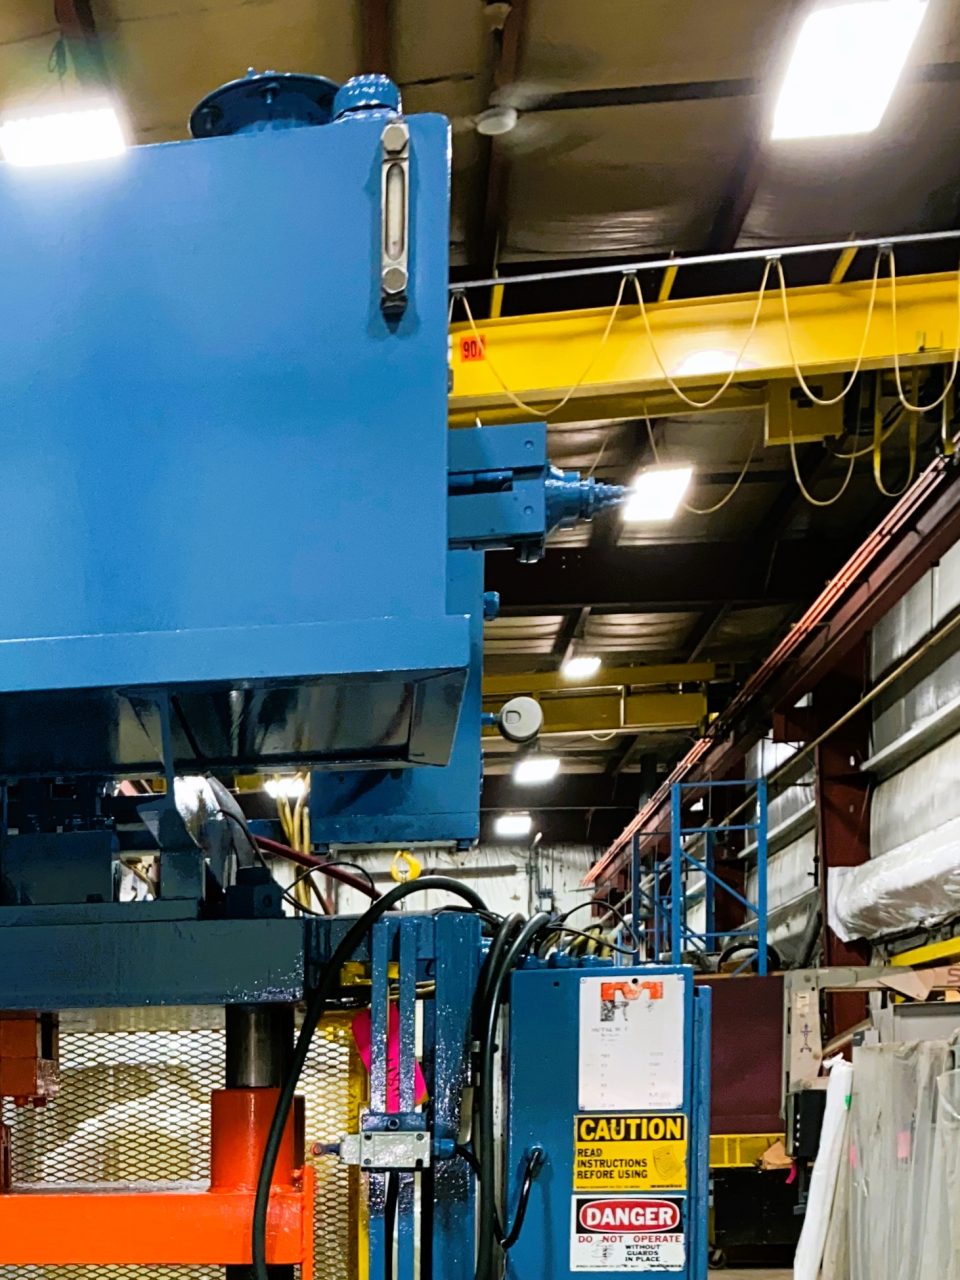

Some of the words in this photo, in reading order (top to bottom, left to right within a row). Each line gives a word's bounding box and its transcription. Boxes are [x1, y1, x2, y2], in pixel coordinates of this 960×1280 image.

[579, 1117, 682, 1141] CAUTION
[576, 1148, 603, 1157] READ
[576, 1158, 648, 1168] INSTRUCTIONS
[576, 1169, 615, 1179] BEFORE
[617, 1169, 648, 1179] USING
[586, 1207, 674, 1226] DANGER
[578, 1235, 593, 1243] DO
[602, 1235, 624, 1243] NOT
[633, 1235, 682, 1243] OPERATE
